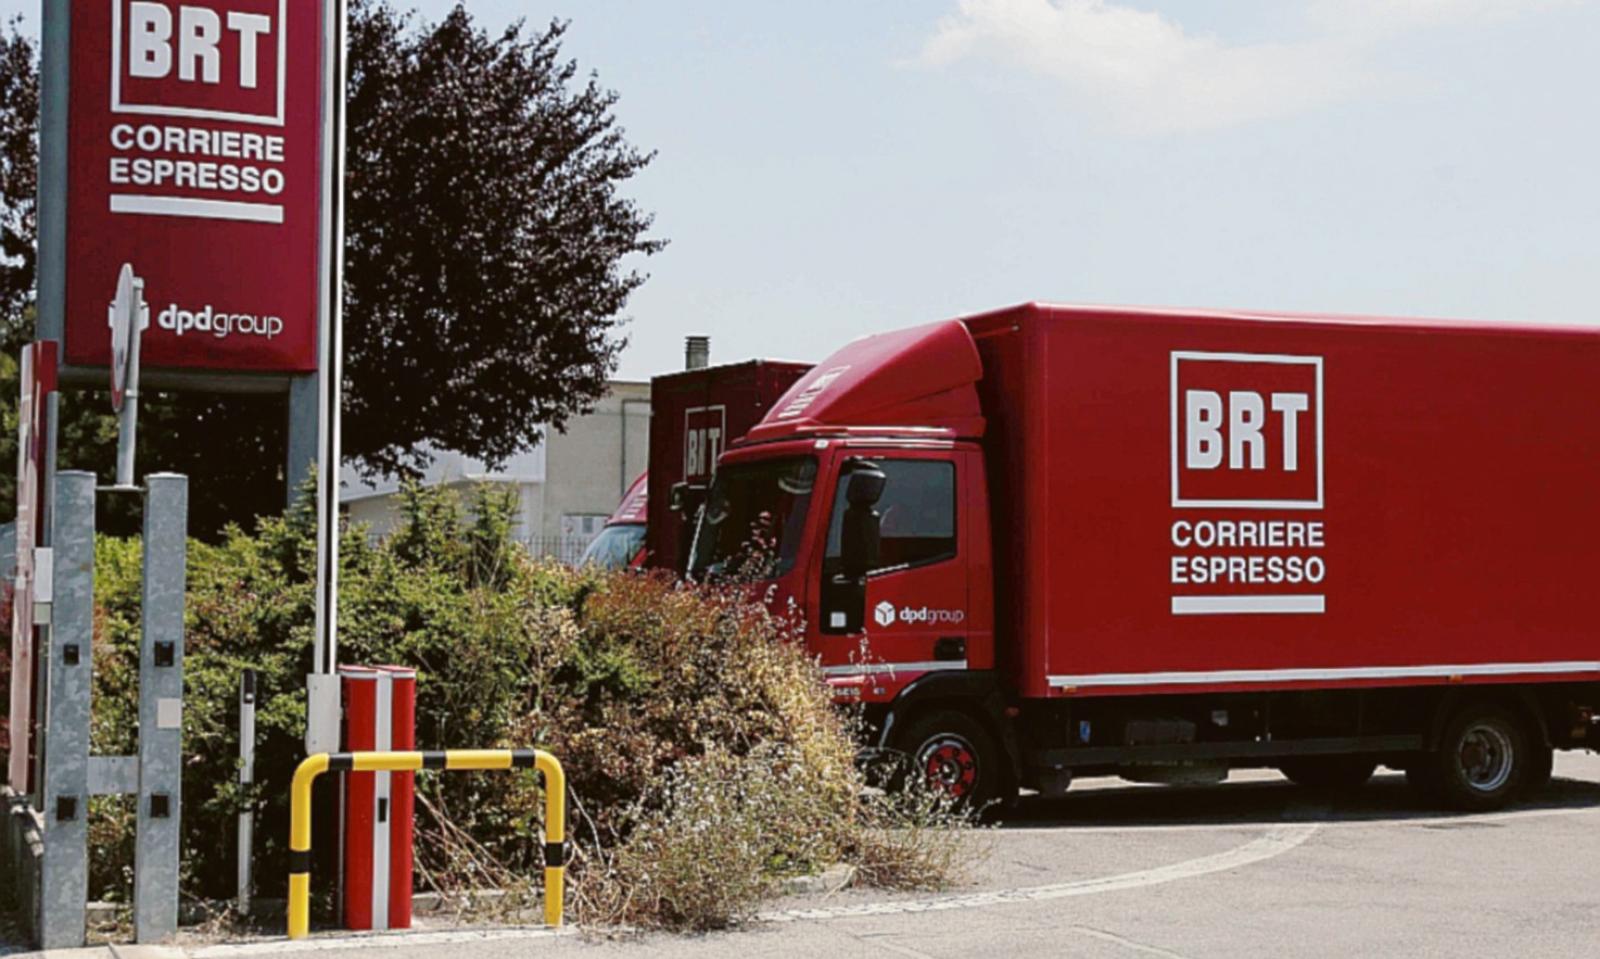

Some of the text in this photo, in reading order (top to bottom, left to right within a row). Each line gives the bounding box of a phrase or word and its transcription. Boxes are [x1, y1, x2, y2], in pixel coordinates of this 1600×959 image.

[130, 1, 271, 88] BRT
[110, 124, 285, 162] CORRIERE
[110, 157, 285, 195] ESPRESSO
[157, 303, 283, 339] dpdgroup
[1186, 389, 1309, 471] BRT
[1171, 520, 1325, 547] CORRIERE
[1171, 556, 1325, 584] ESPRESSO
[899, 606, 965, 624] dpdgroup
